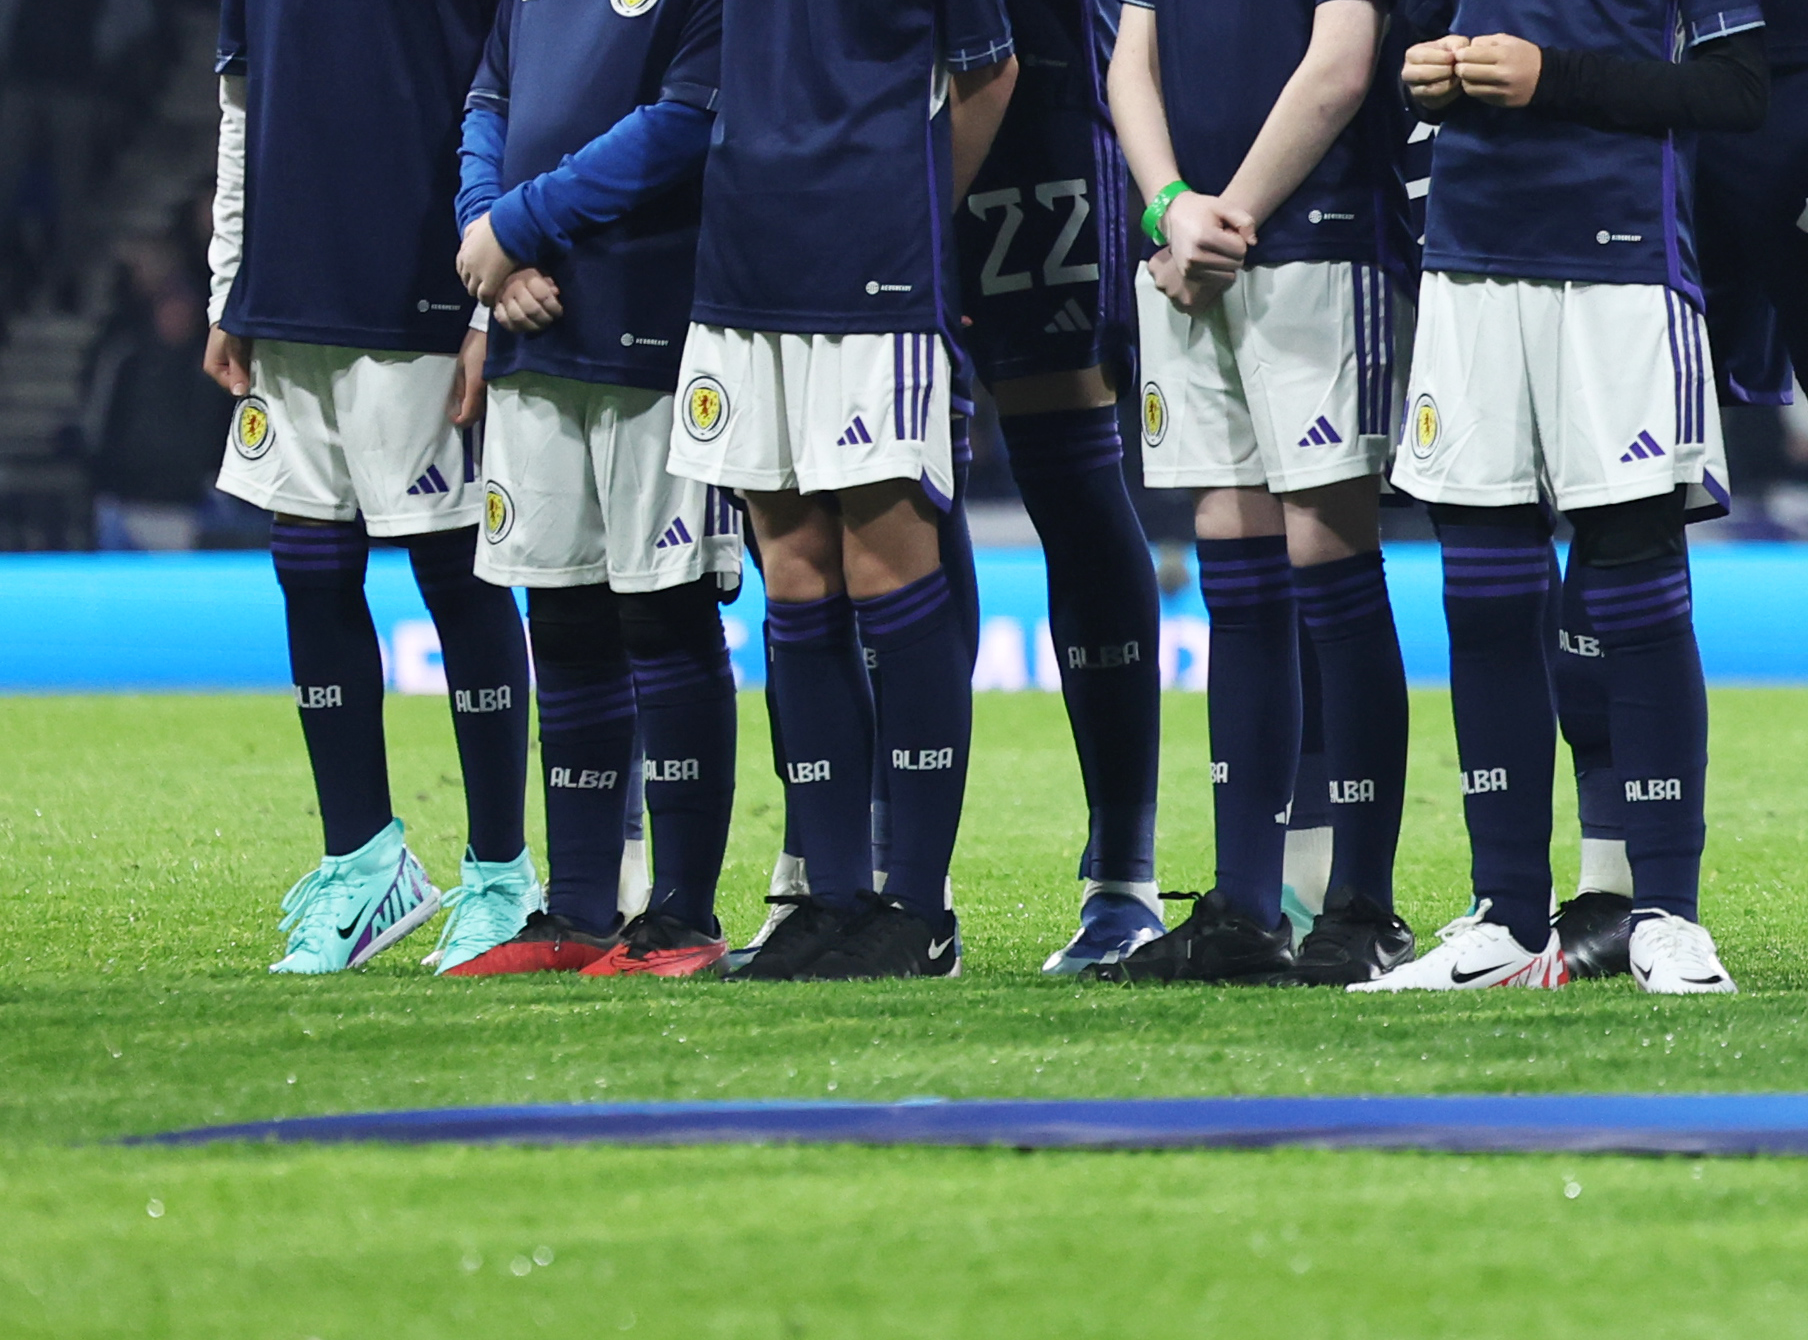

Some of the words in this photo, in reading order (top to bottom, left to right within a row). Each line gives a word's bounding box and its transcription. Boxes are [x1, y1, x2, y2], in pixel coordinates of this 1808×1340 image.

[967, 178, 1100, 297] 22
[1069, 640, 1140, 669] ALBA
[1559, 628, 1604, 657] ALB
[455, 685, 511, 713] ALBA
[892, 747, 954, 770] ALBA
[550, 766, 618, 790] ALBA
[787, 760, 831, 783] LBA
[1210, 761, 1229, 783] BA
[1625, 778, 1681, 801] ALBA
